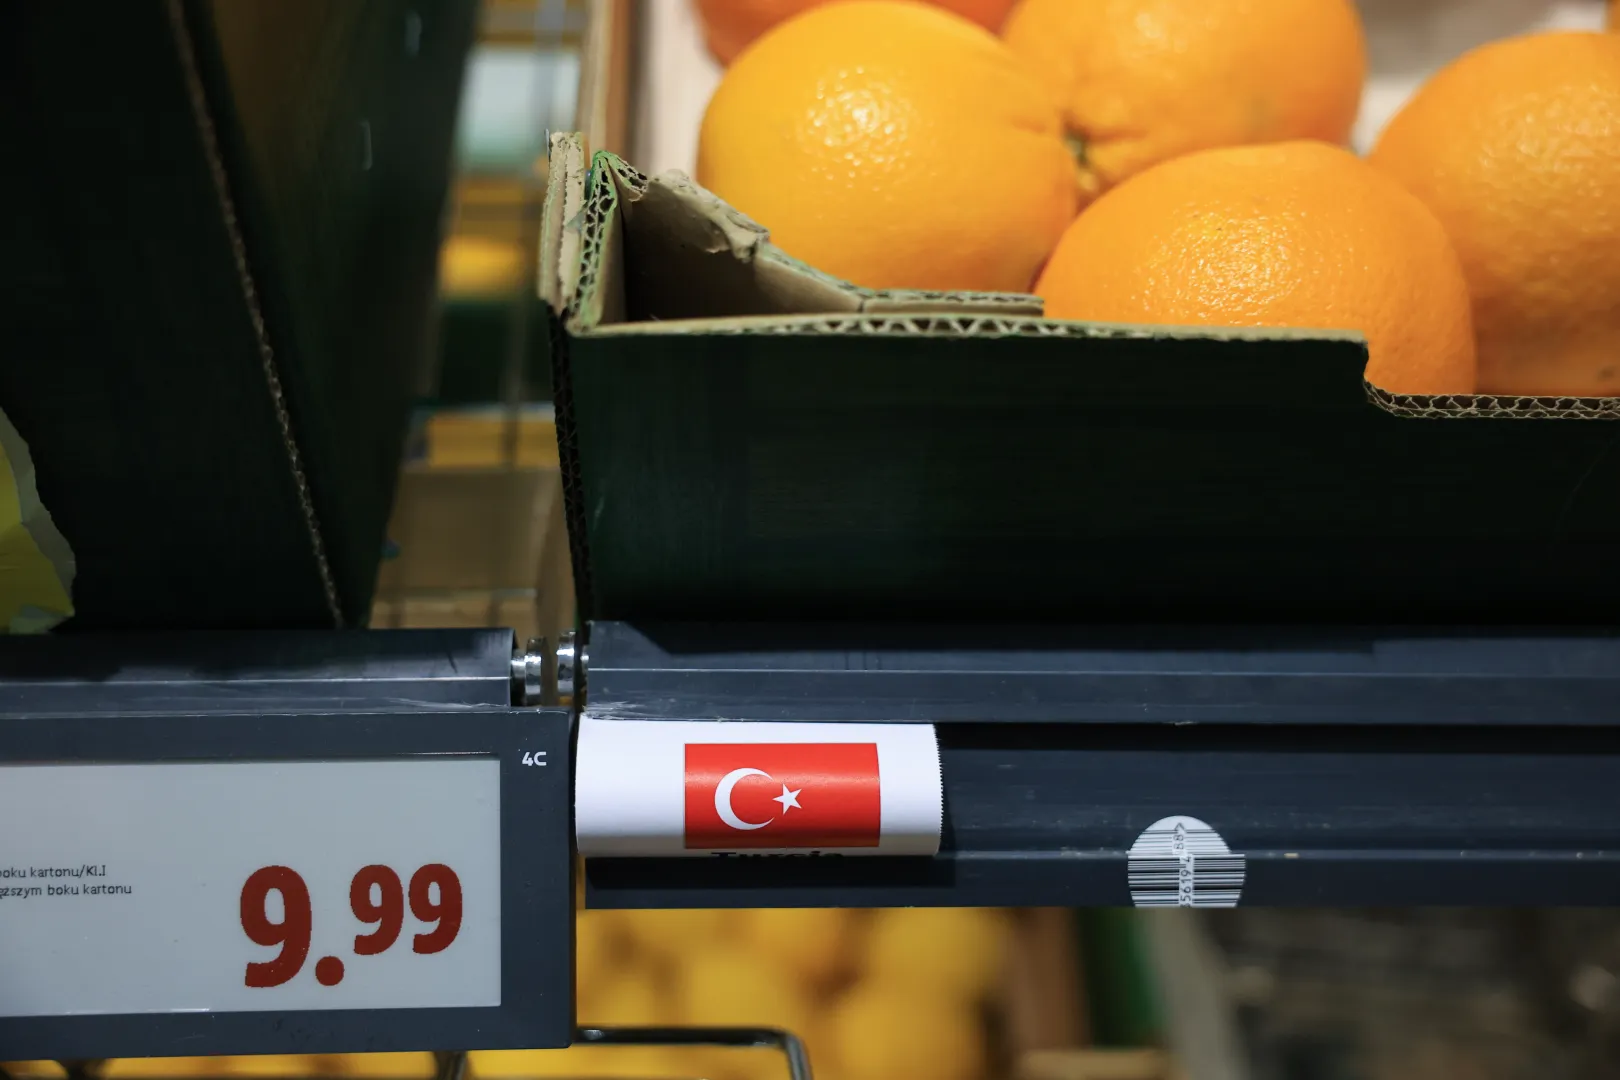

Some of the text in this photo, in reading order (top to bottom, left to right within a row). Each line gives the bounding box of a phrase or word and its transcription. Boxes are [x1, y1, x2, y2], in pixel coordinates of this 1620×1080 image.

[521, 751, 547, 767] 4C
[47, 884, 79, 896] boku
[83, 883, 132, 895] kartonu
[240, 863, 462, 988] 9.99
